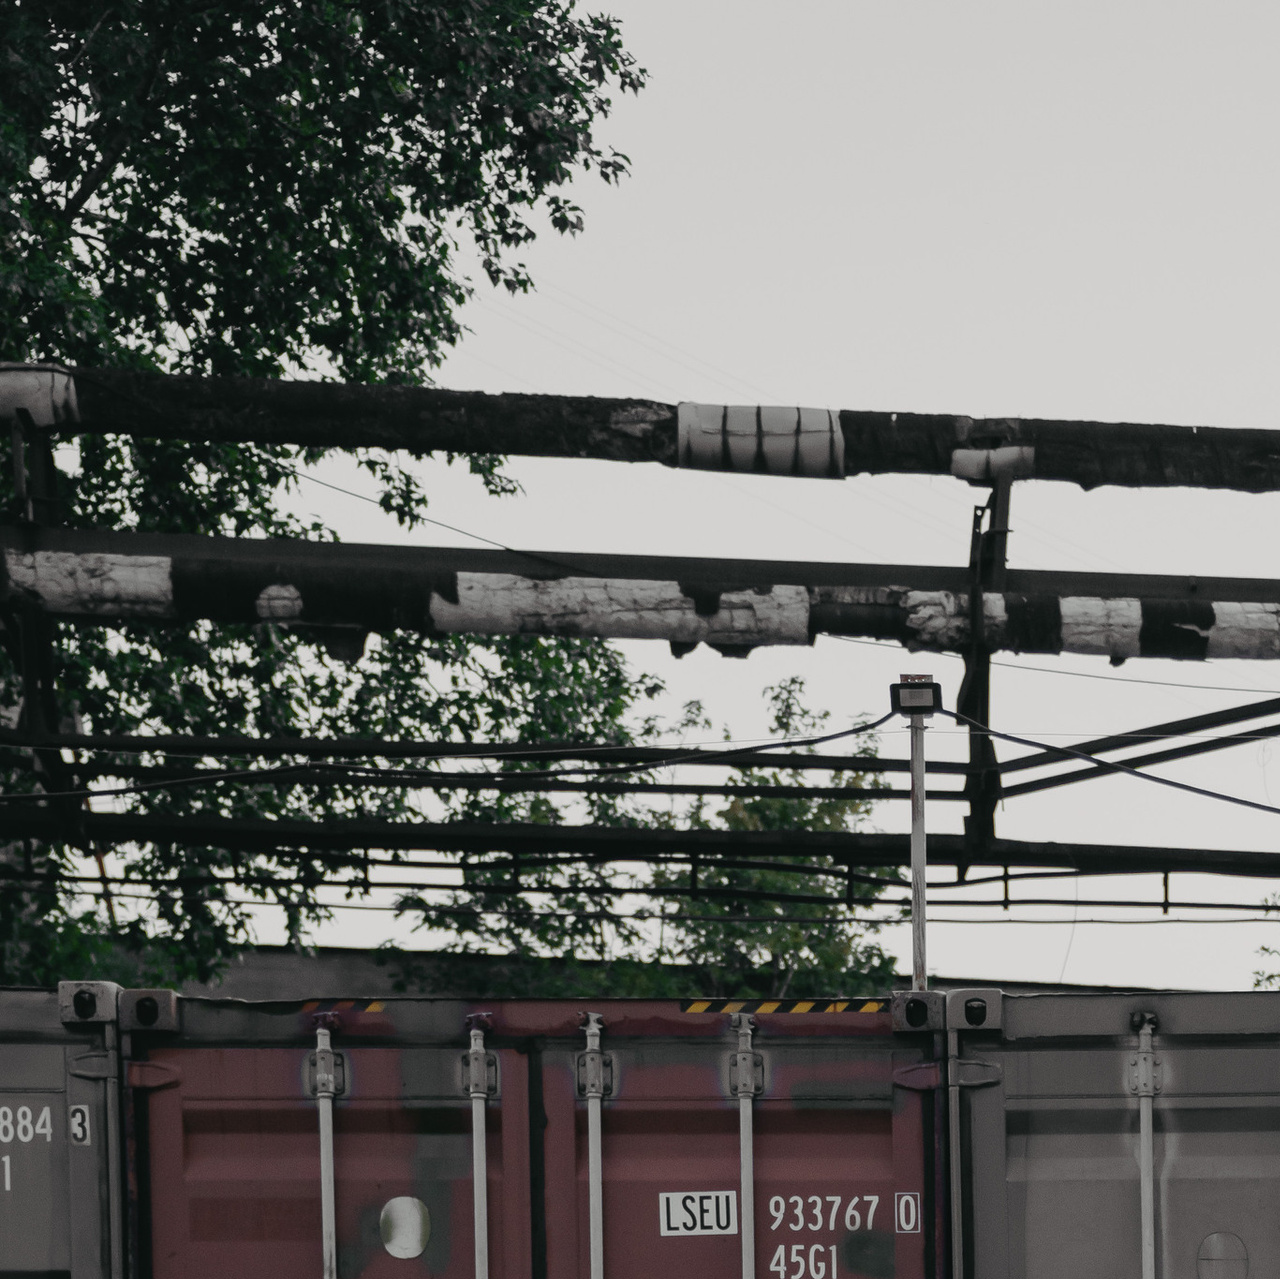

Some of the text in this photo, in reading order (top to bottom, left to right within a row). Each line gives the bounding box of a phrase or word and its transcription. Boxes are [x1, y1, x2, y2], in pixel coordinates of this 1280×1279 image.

[71, 1107, 88, 1143] 3
[665, 1194, 916, 1232] LSEU 933767 0
[769, 1244, 837, 1279] 45G1
